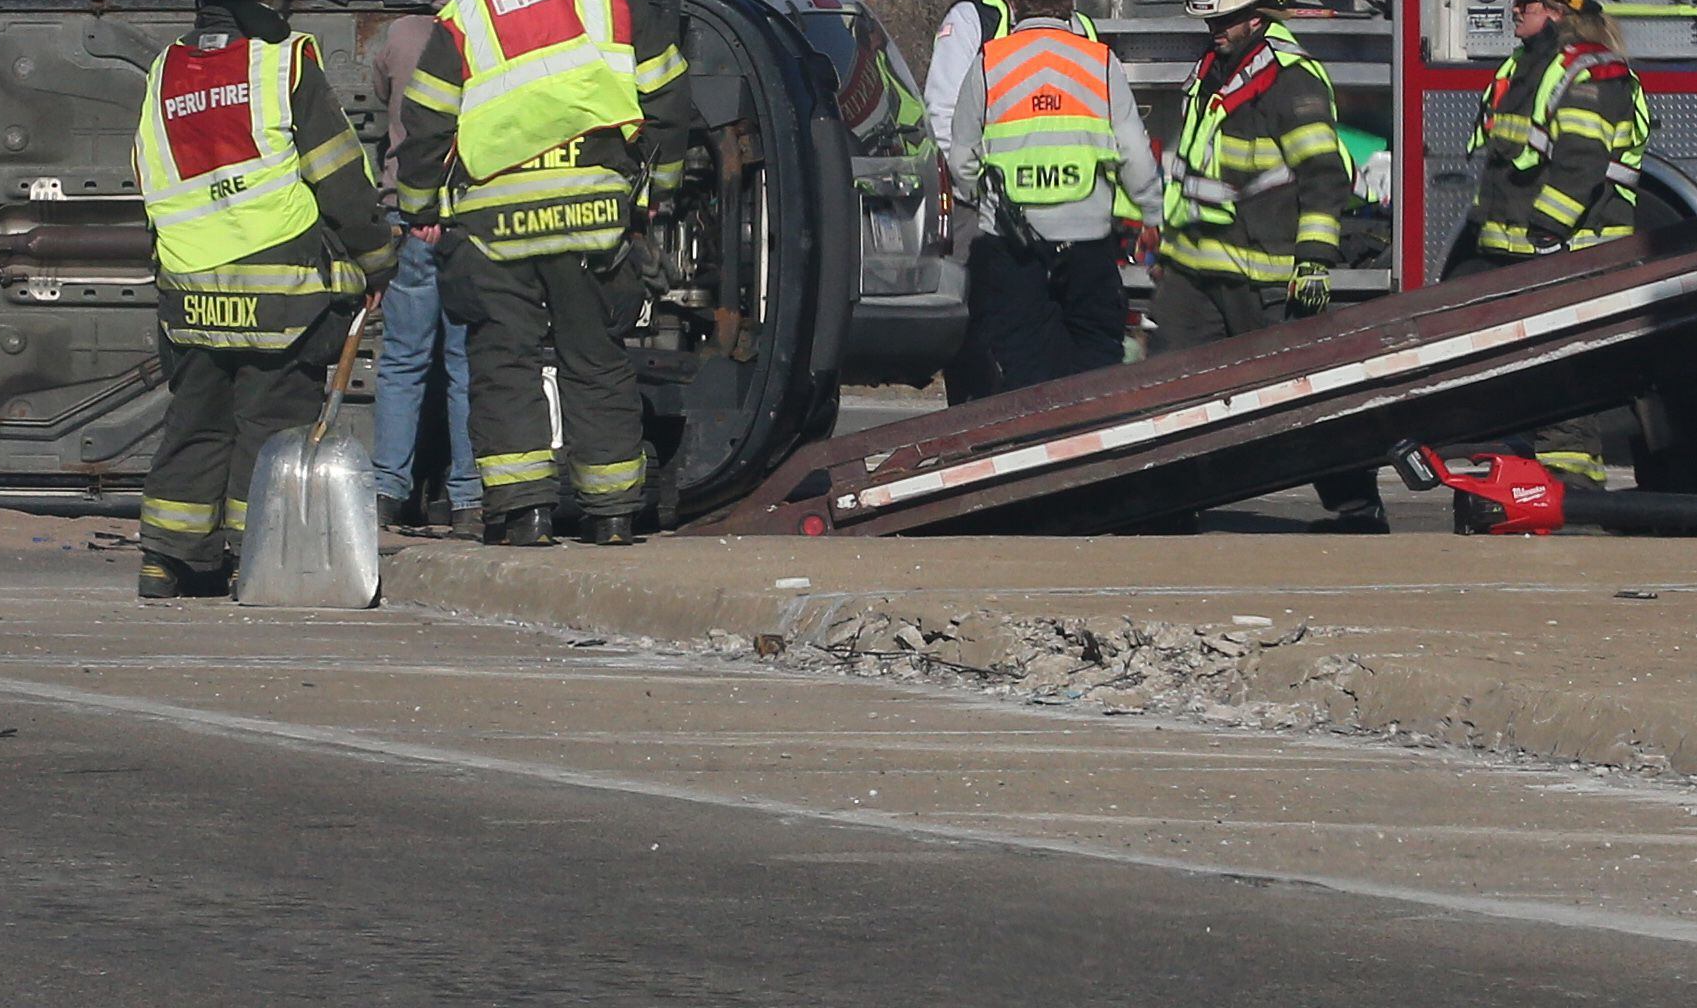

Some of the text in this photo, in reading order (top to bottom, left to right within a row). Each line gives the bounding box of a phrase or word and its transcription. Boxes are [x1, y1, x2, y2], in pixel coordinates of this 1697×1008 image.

[165, 82, 249, 120] PERU FIRE
[1032, 94, 1062, 112] PERU
[209, 175, 248, 202] FIRE
[1016, 164, 1081, 189] EMS
[493, 198, 619, 237] J. CAMENISCH
[184, 295, 259, 328] SHADDIX
